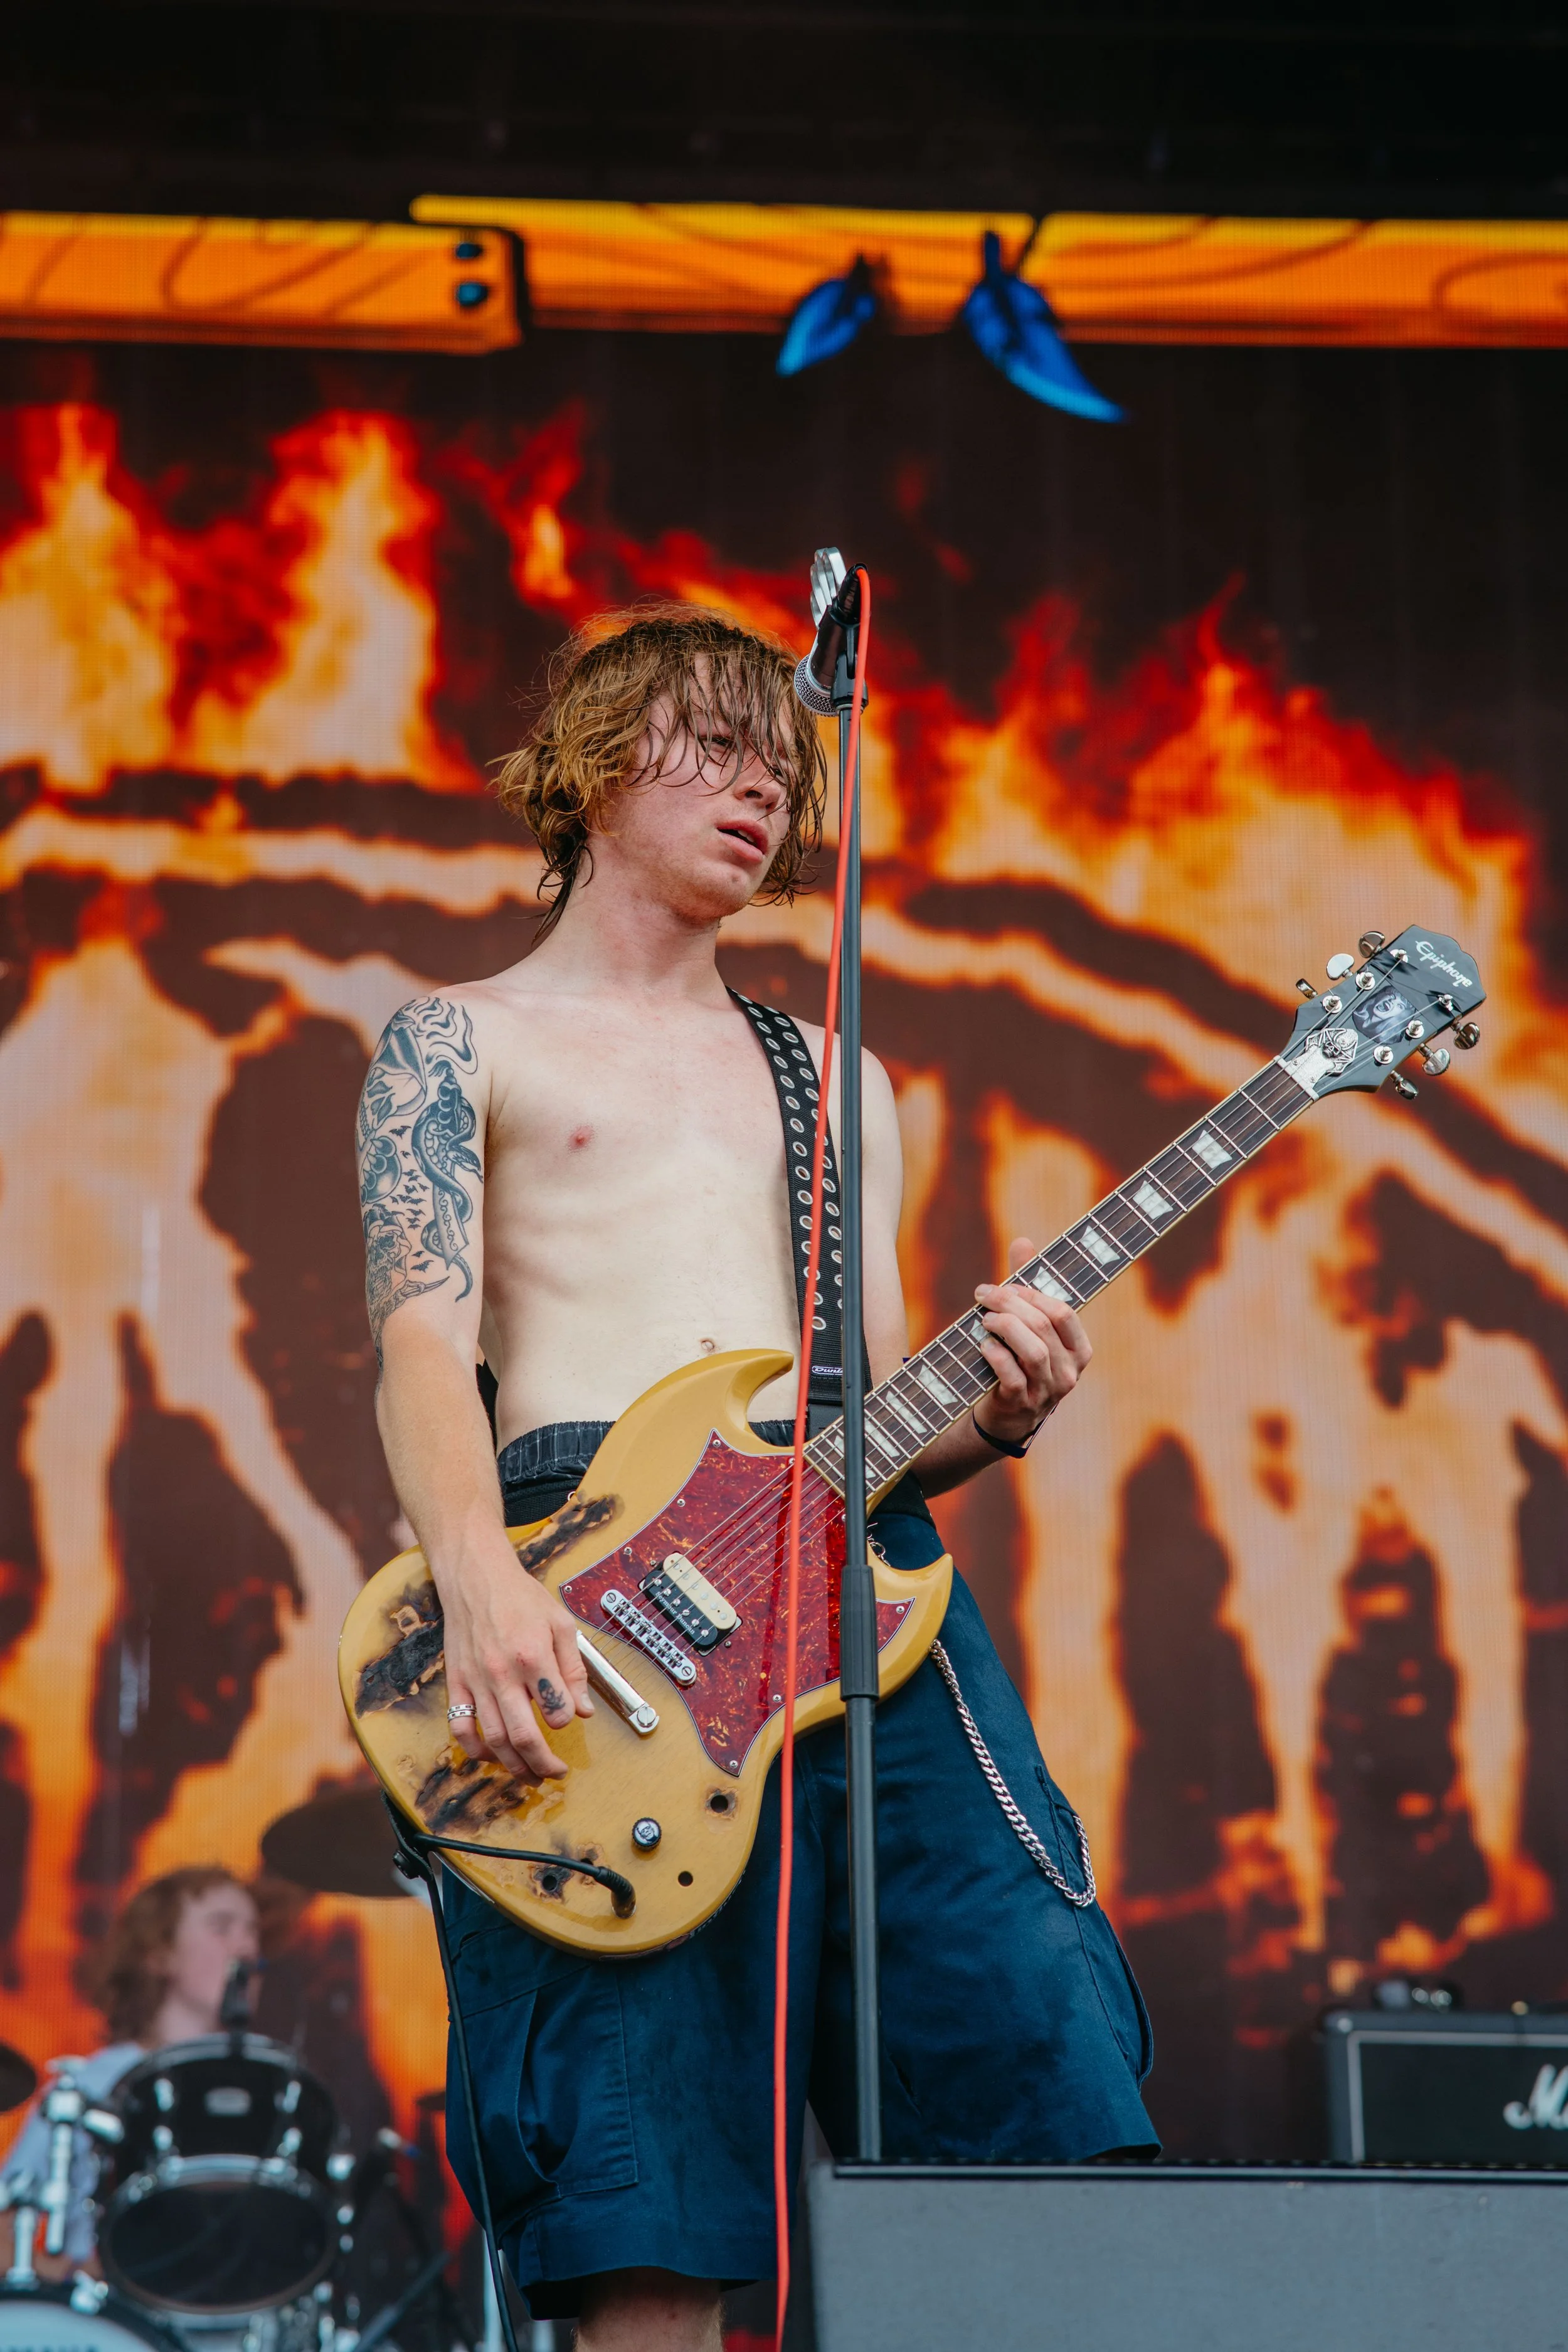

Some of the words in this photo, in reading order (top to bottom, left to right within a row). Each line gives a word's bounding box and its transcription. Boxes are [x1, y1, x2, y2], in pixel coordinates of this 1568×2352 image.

[1415, 941, 1473, 987] Epiphone
[655, 1591, 677, 1615] Seymour
[675, 1613, 696, 1635] Duncan
